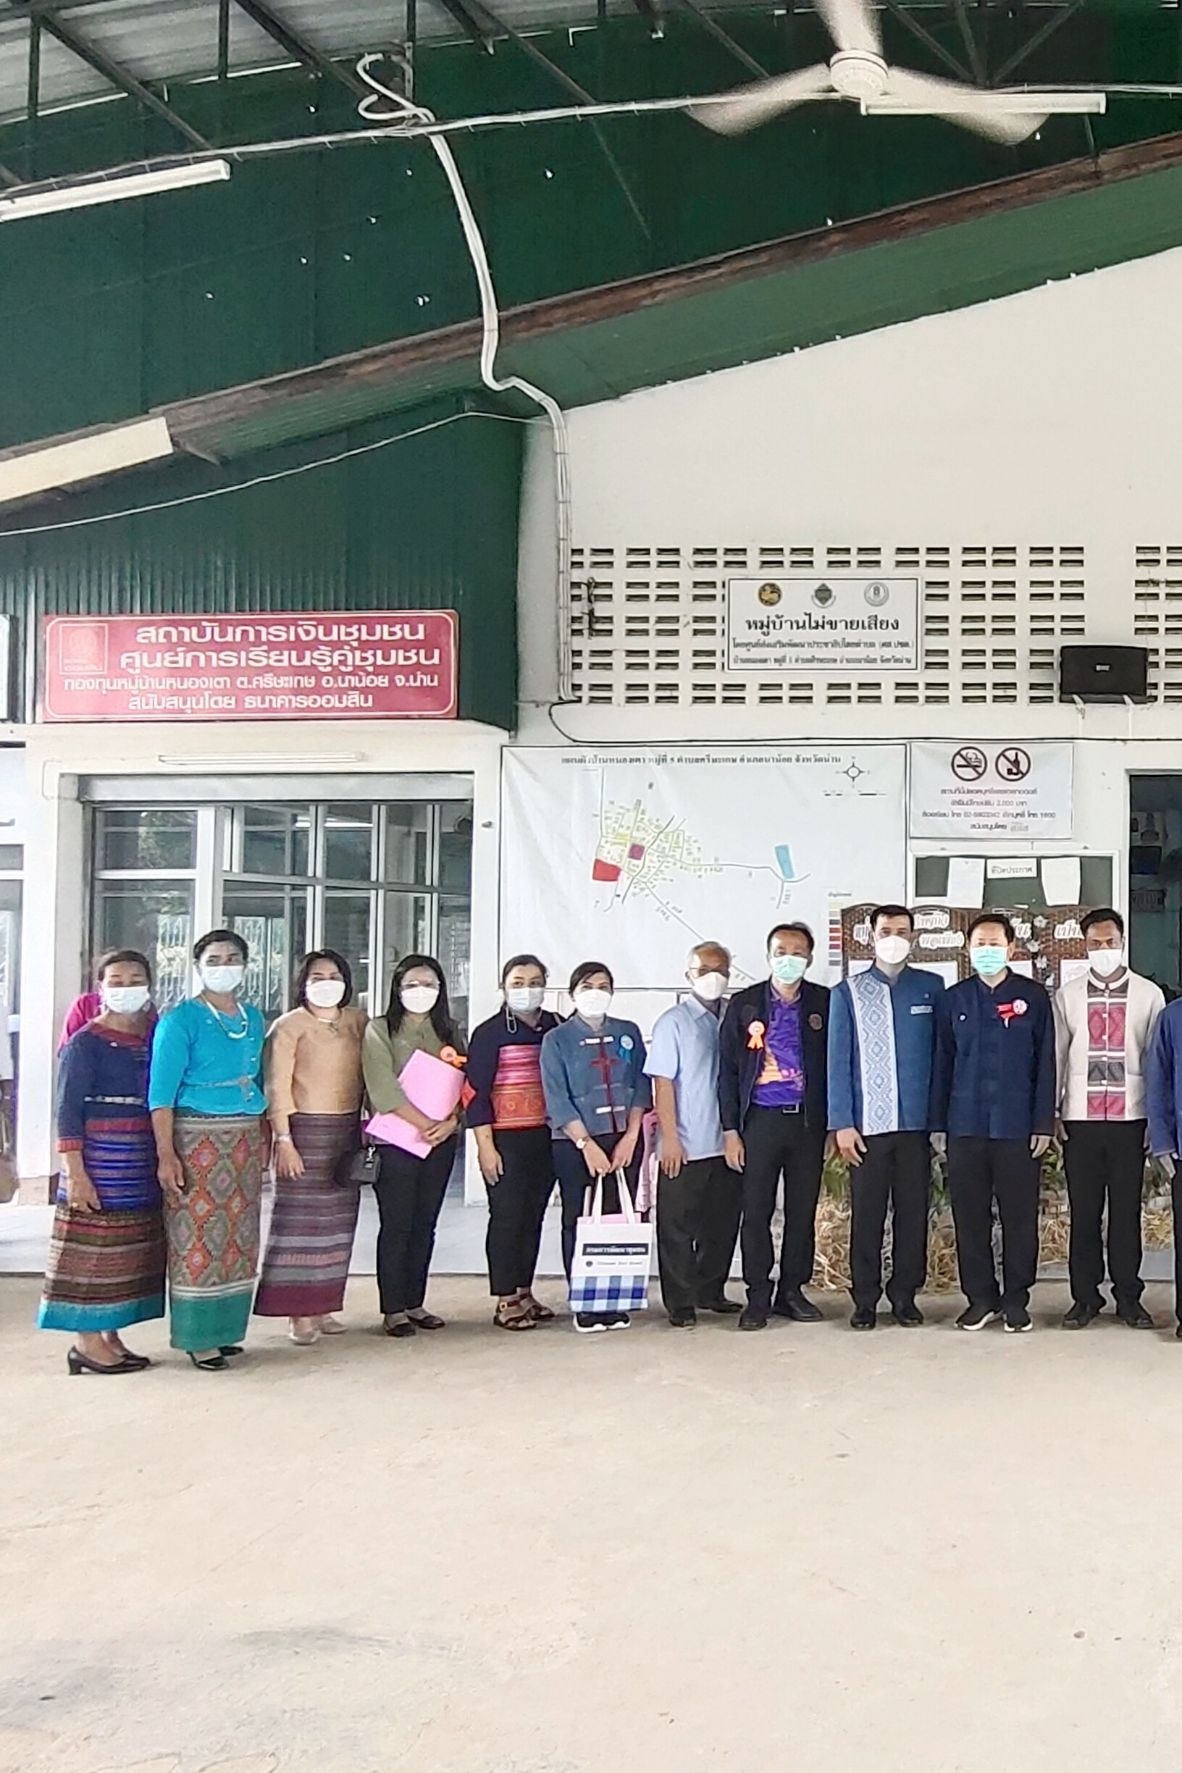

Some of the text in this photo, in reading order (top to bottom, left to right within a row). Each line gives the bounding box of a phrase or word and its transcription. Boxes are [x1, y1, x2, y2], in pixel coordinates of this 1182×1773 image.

[136, 620, 425, 648] สถาบันการเงินชุมชน
[745, 612, 900, 637] หมู่บ้านไม่ขายเสียง
[120, 645, 440, 674] ศูนย์การเรียนรู้คู่ชุมชน
[64, 670, 438, 695] กองทุนหมู่บ้านหนองเตา ต.ศรีษะเกษ อ.นาน้อย จ.น่าน
[128, 690, 374, 714] สนับสนุนโดย ธนาคารออมสิน
